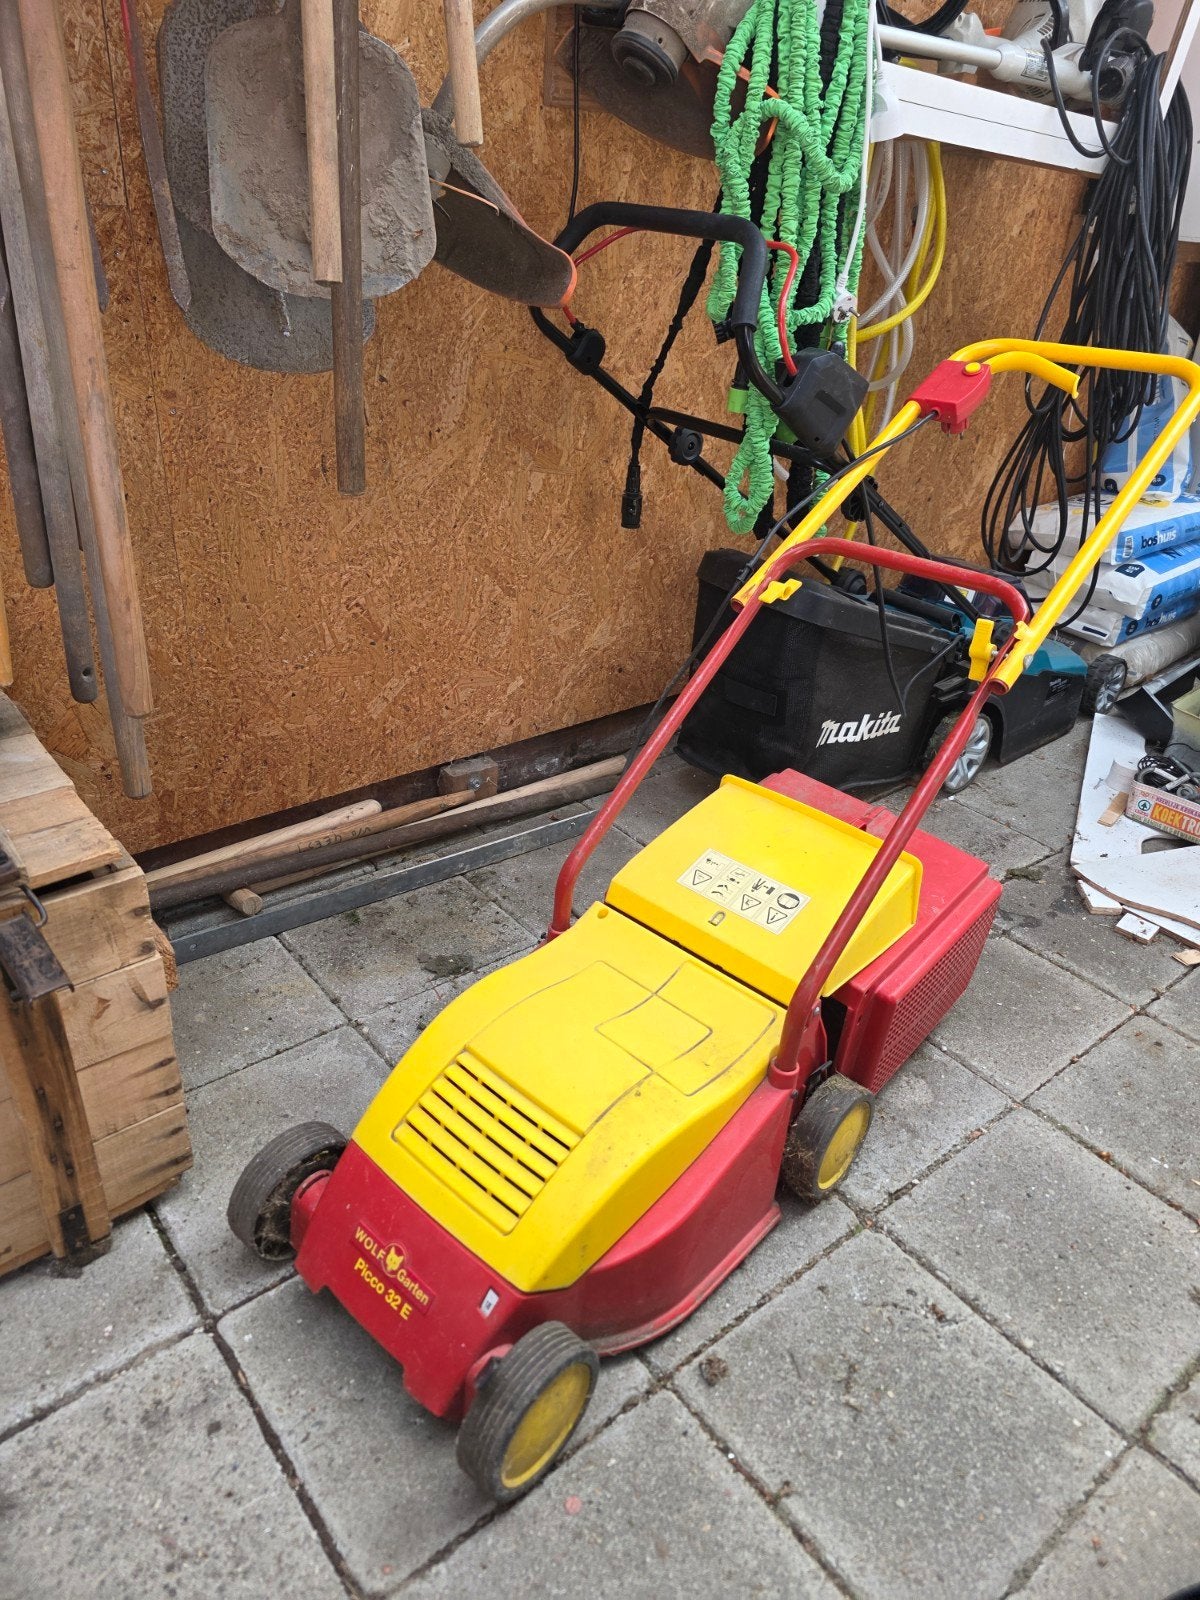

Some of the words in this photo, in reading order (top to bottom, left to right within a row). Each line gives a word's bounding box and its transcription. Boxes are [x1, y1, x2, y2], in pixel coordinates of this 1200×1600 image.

[1141, 530, 1177, 549] boshuis
[815, 711, 902, 749] makita
[354, 1257, 385, 1294] Picco
[384, 1288, 402, 1311] 32
[399, 1302, 413, 1321] E
[355, 1226, 386, 1260] WOLF
[397, 1268, 429, 1306] Garten
